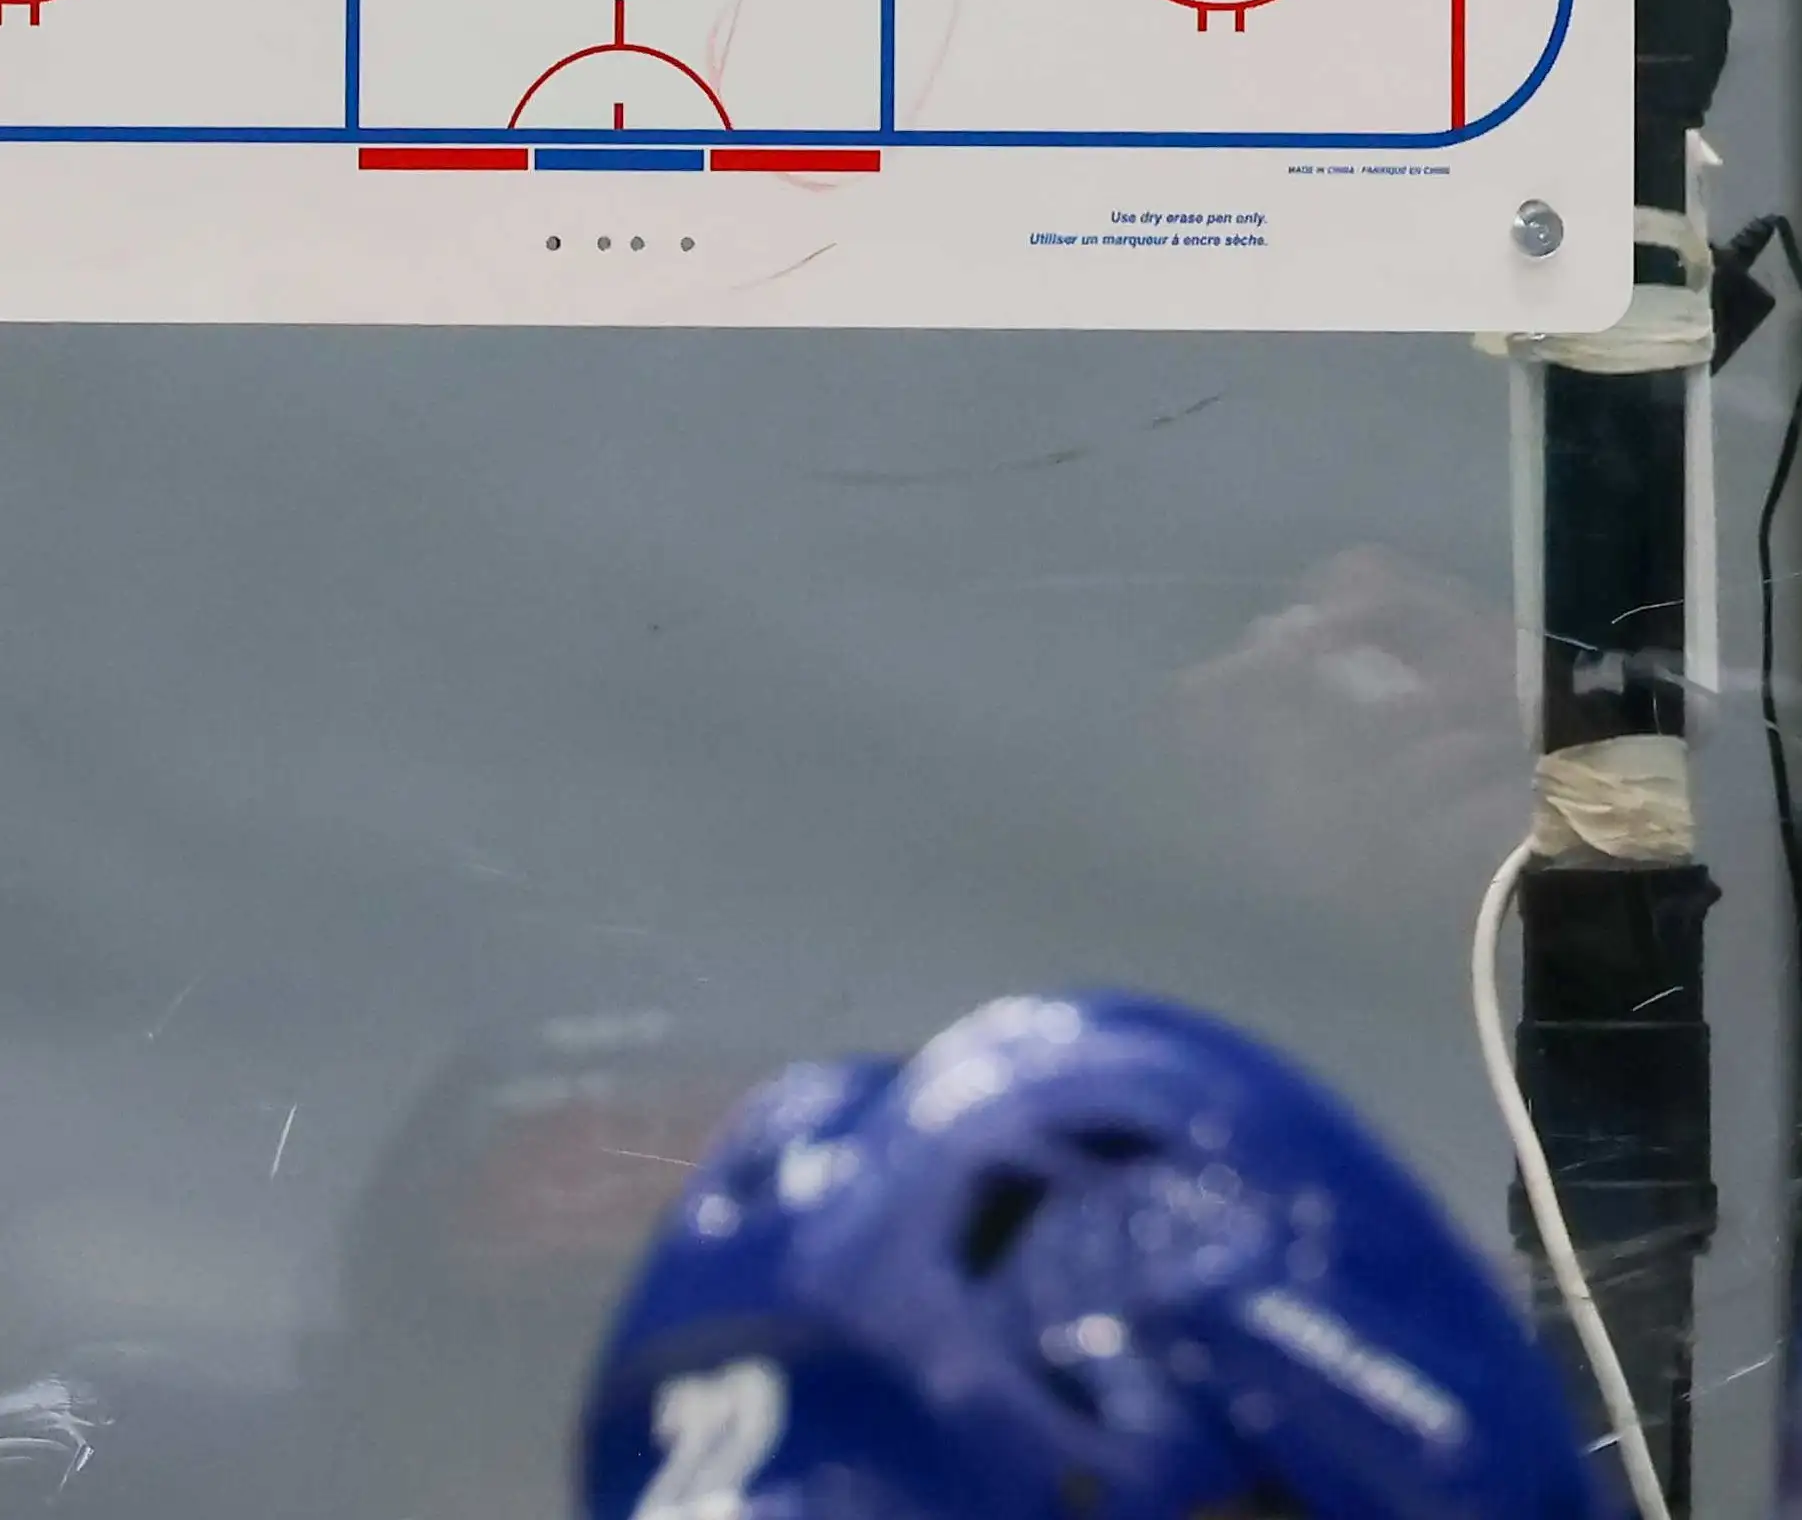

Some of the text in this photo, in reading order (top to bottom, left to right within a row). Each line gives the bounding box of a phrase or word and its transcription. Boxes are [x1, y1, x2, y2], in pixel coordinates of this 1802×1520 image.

[1111, 211, 1268, 227] Use dry erase pen only.
[1030, 232, 1077, 245] Utiliser
[1081, 235, 1099, 245] un
[1102, 235, 1168, 248] marqueur
[1183, 235, 1221, 246] encre
